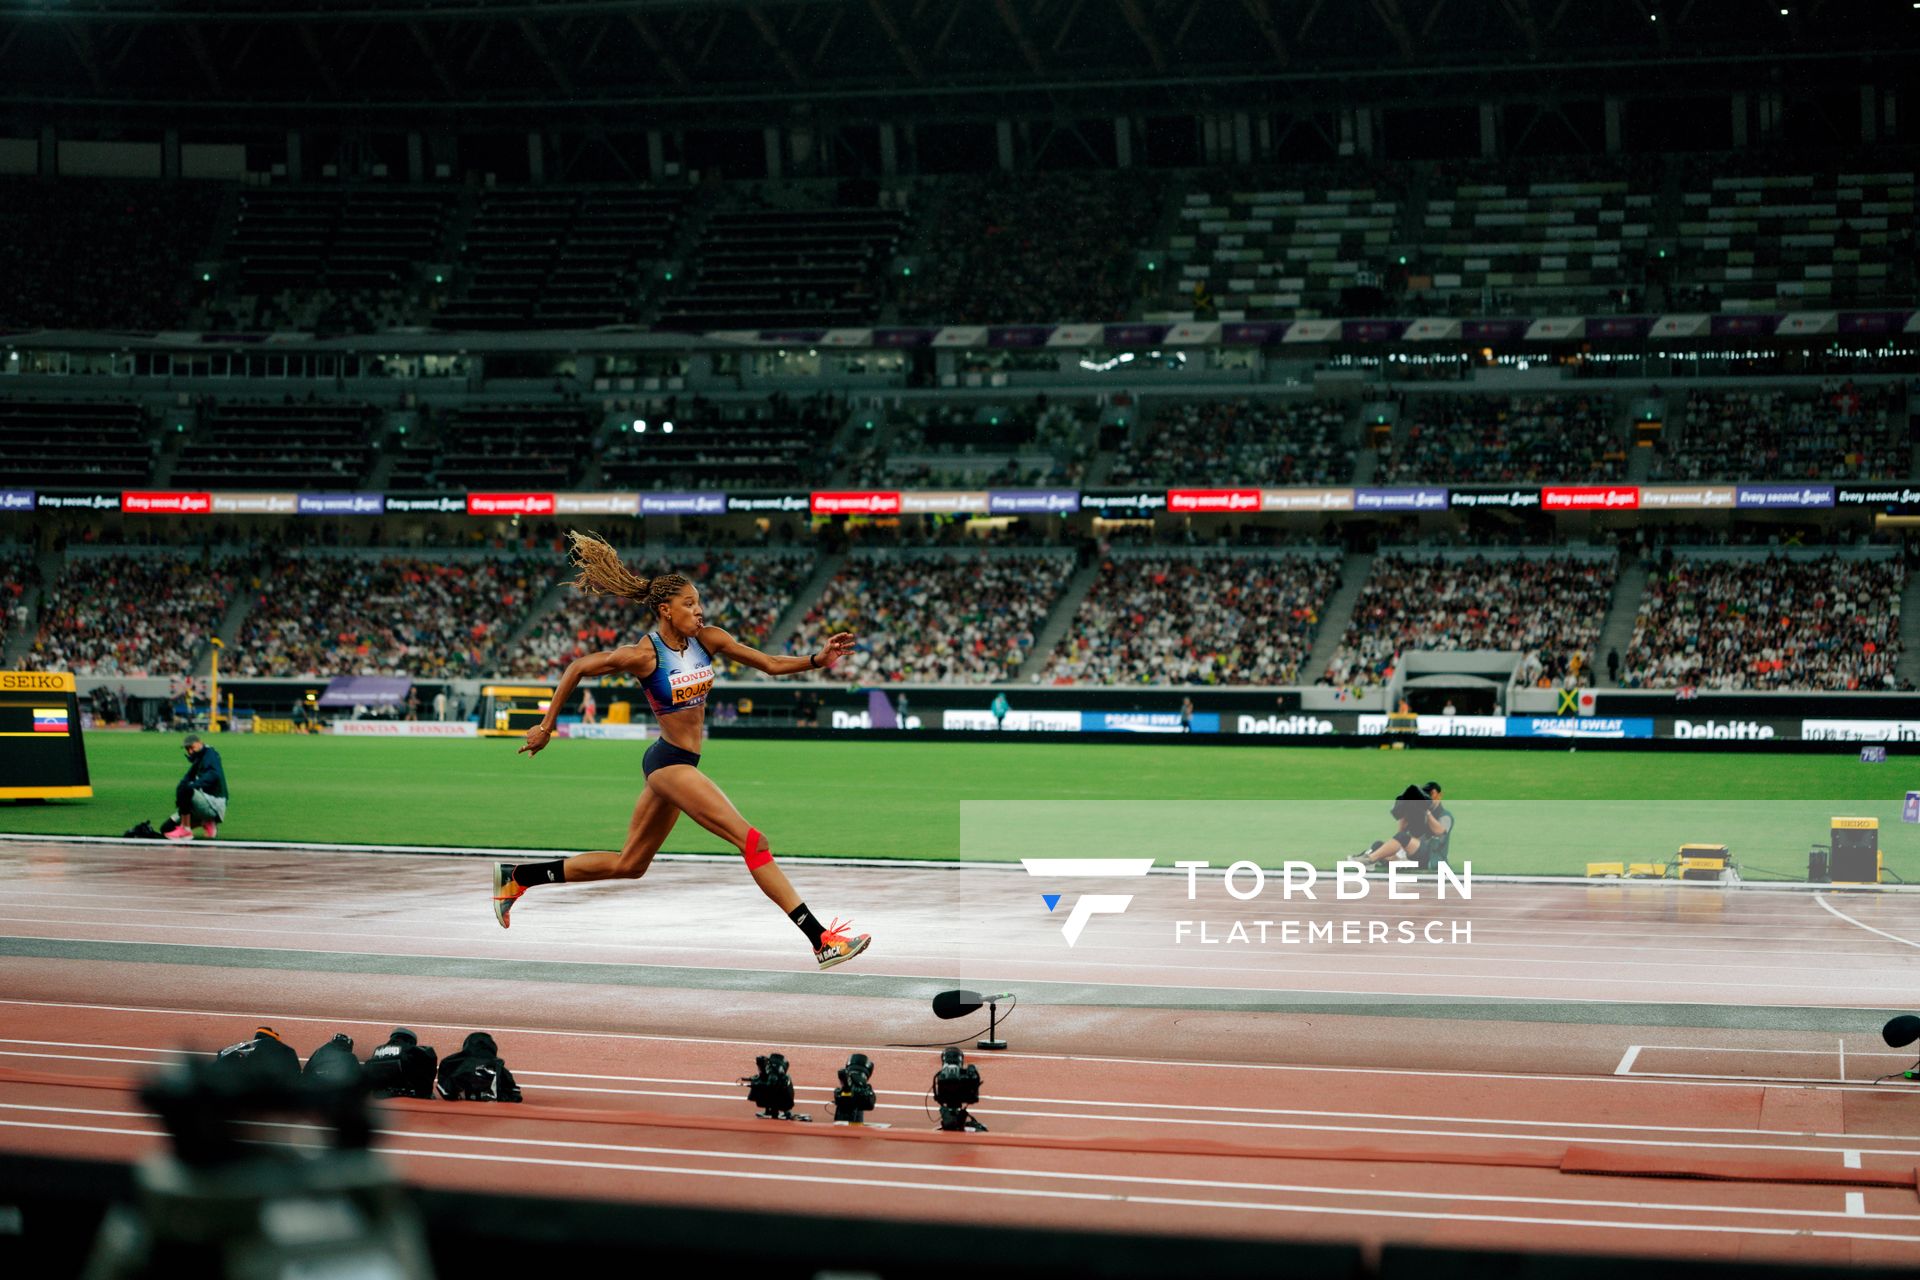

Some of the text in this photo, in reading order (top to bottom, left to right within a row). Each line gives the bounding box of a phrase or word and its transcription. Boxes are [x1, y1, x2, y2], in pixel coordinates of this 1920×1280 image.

[1839, 491, 1865, 503] Every
[3, 675, 64, 689] SEIKO
[671, 669, 713, 685] HONDA
[676, 680, 713, 701] ROJAS
[343, 723, 399, 733] HONDA
[409, 723, 466, 734] HONDA
[1237, 714, 1334, 734] Deloitte
[1532, 718, 1623, 730] POCARI SWEAT
[1674, 719, 1775, 740] Deloitte
